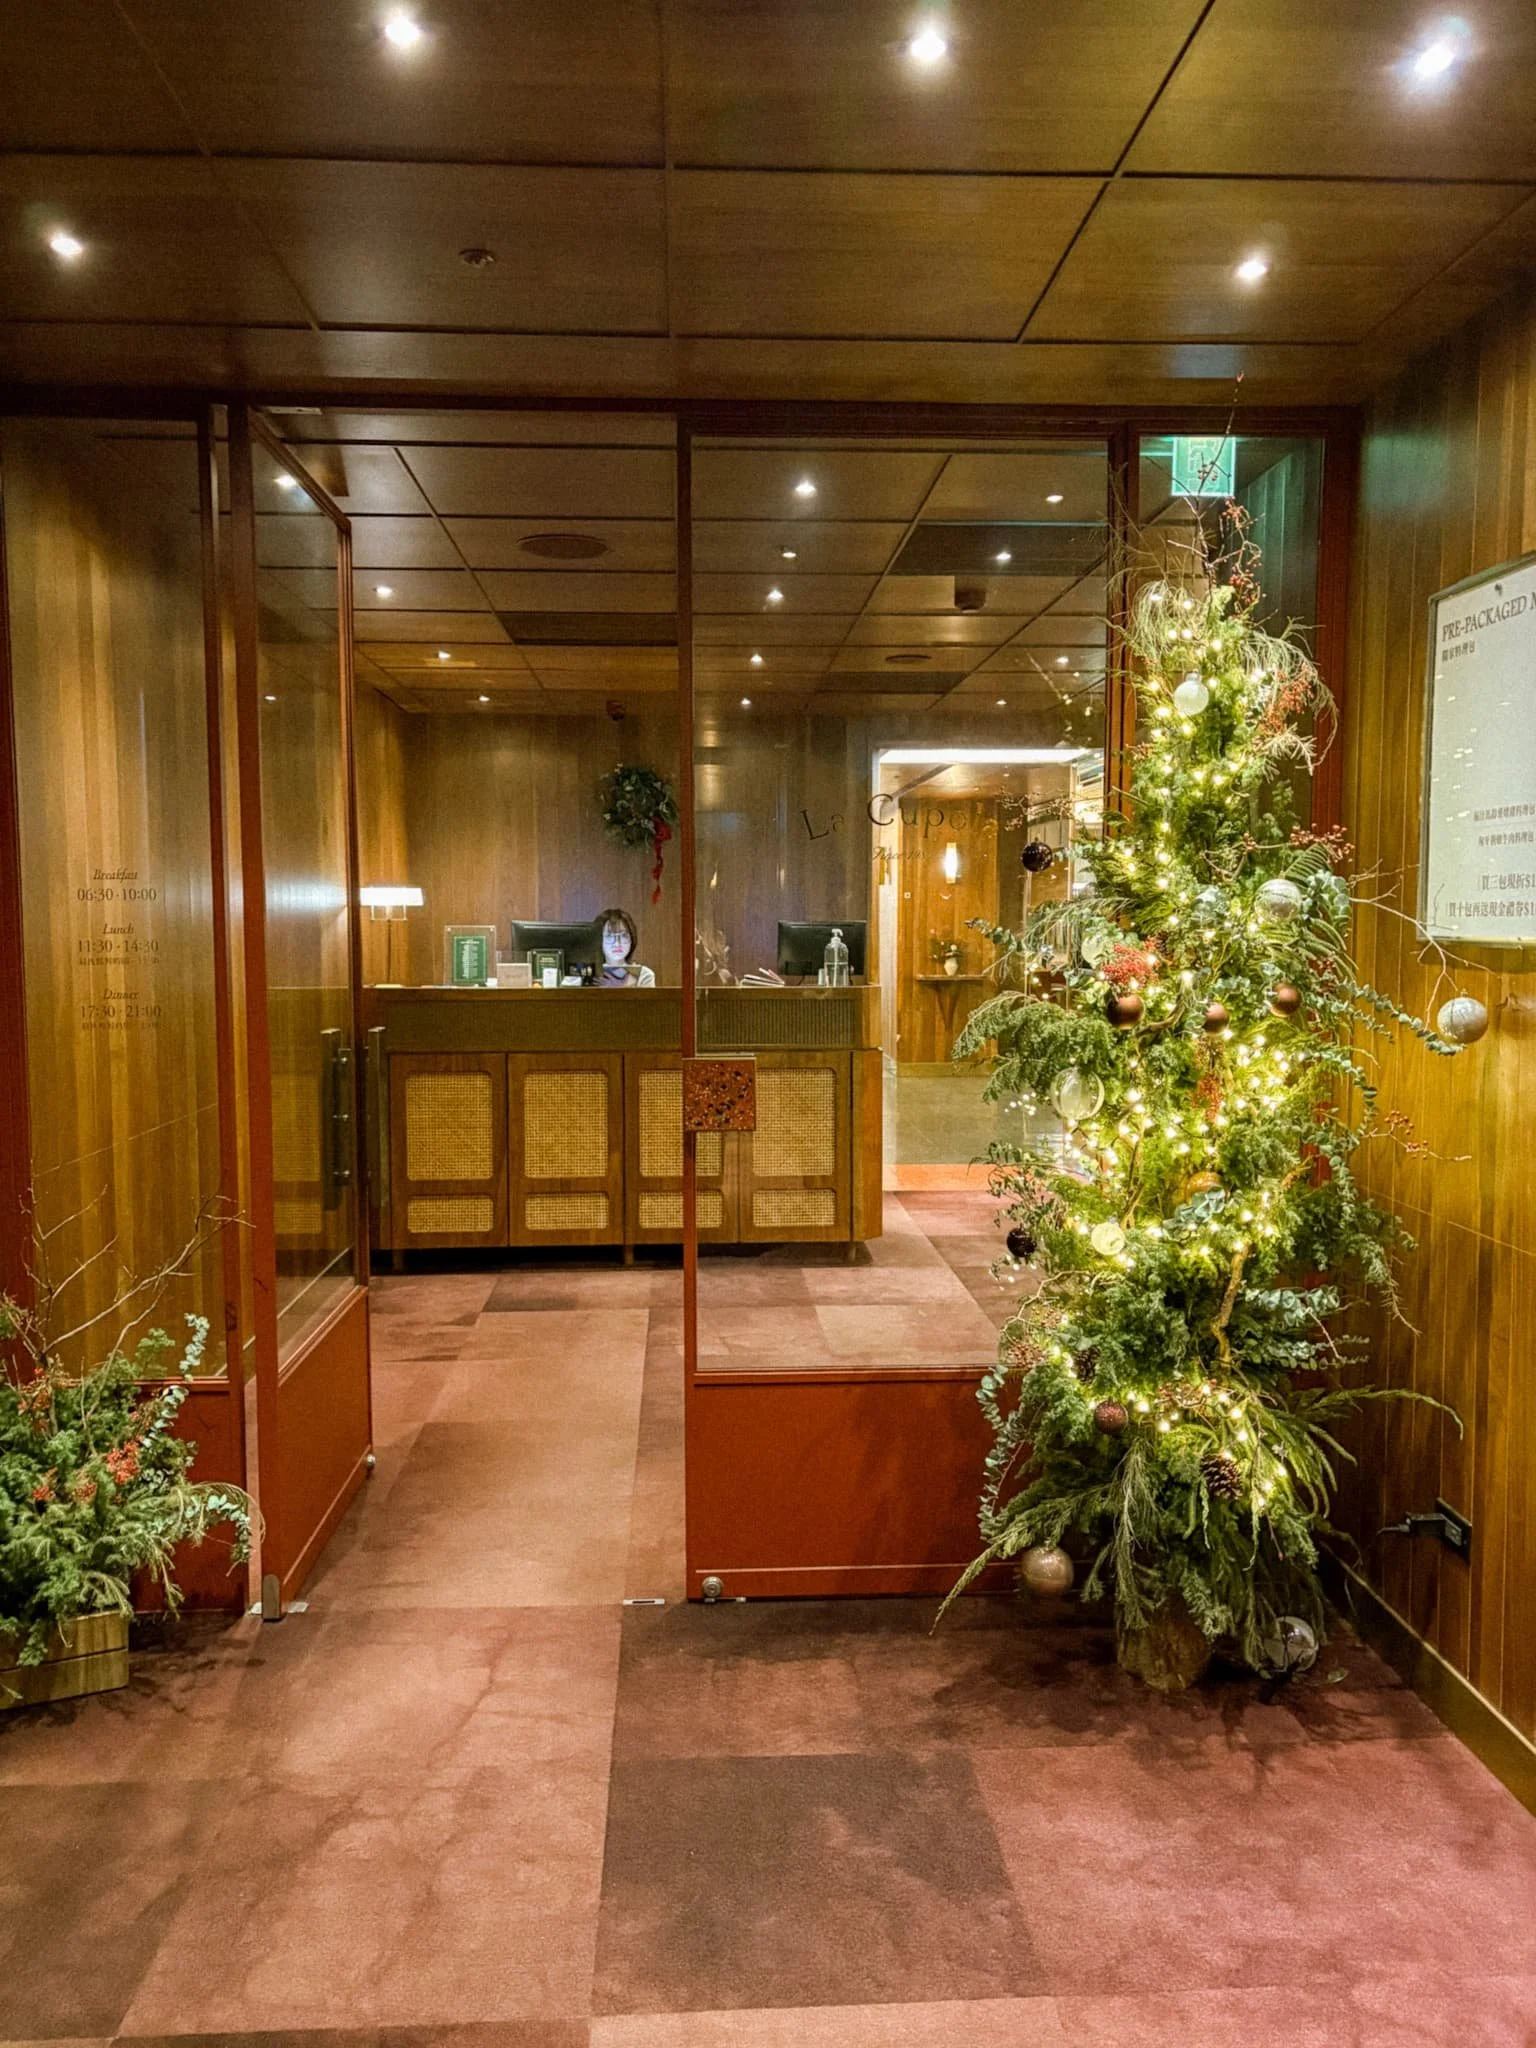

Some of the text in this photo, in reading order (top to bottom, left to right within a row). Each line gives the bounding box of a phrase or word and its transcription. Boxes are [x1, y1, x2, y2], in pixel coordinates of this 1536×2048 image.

[1442, 595, 1527, 641] PRE-PACKAGED
[800, 809, 845, 840] La
[93, 867, 138, 883] Breakfast
[77, 888, 113, 901] 06:30
[123, 888, 157, 901] 10:00
[102, 923, 135, 934] Lunch
[79, 939, 113, 953] 11:30
[103, 988, 140, 1000] Dinner
